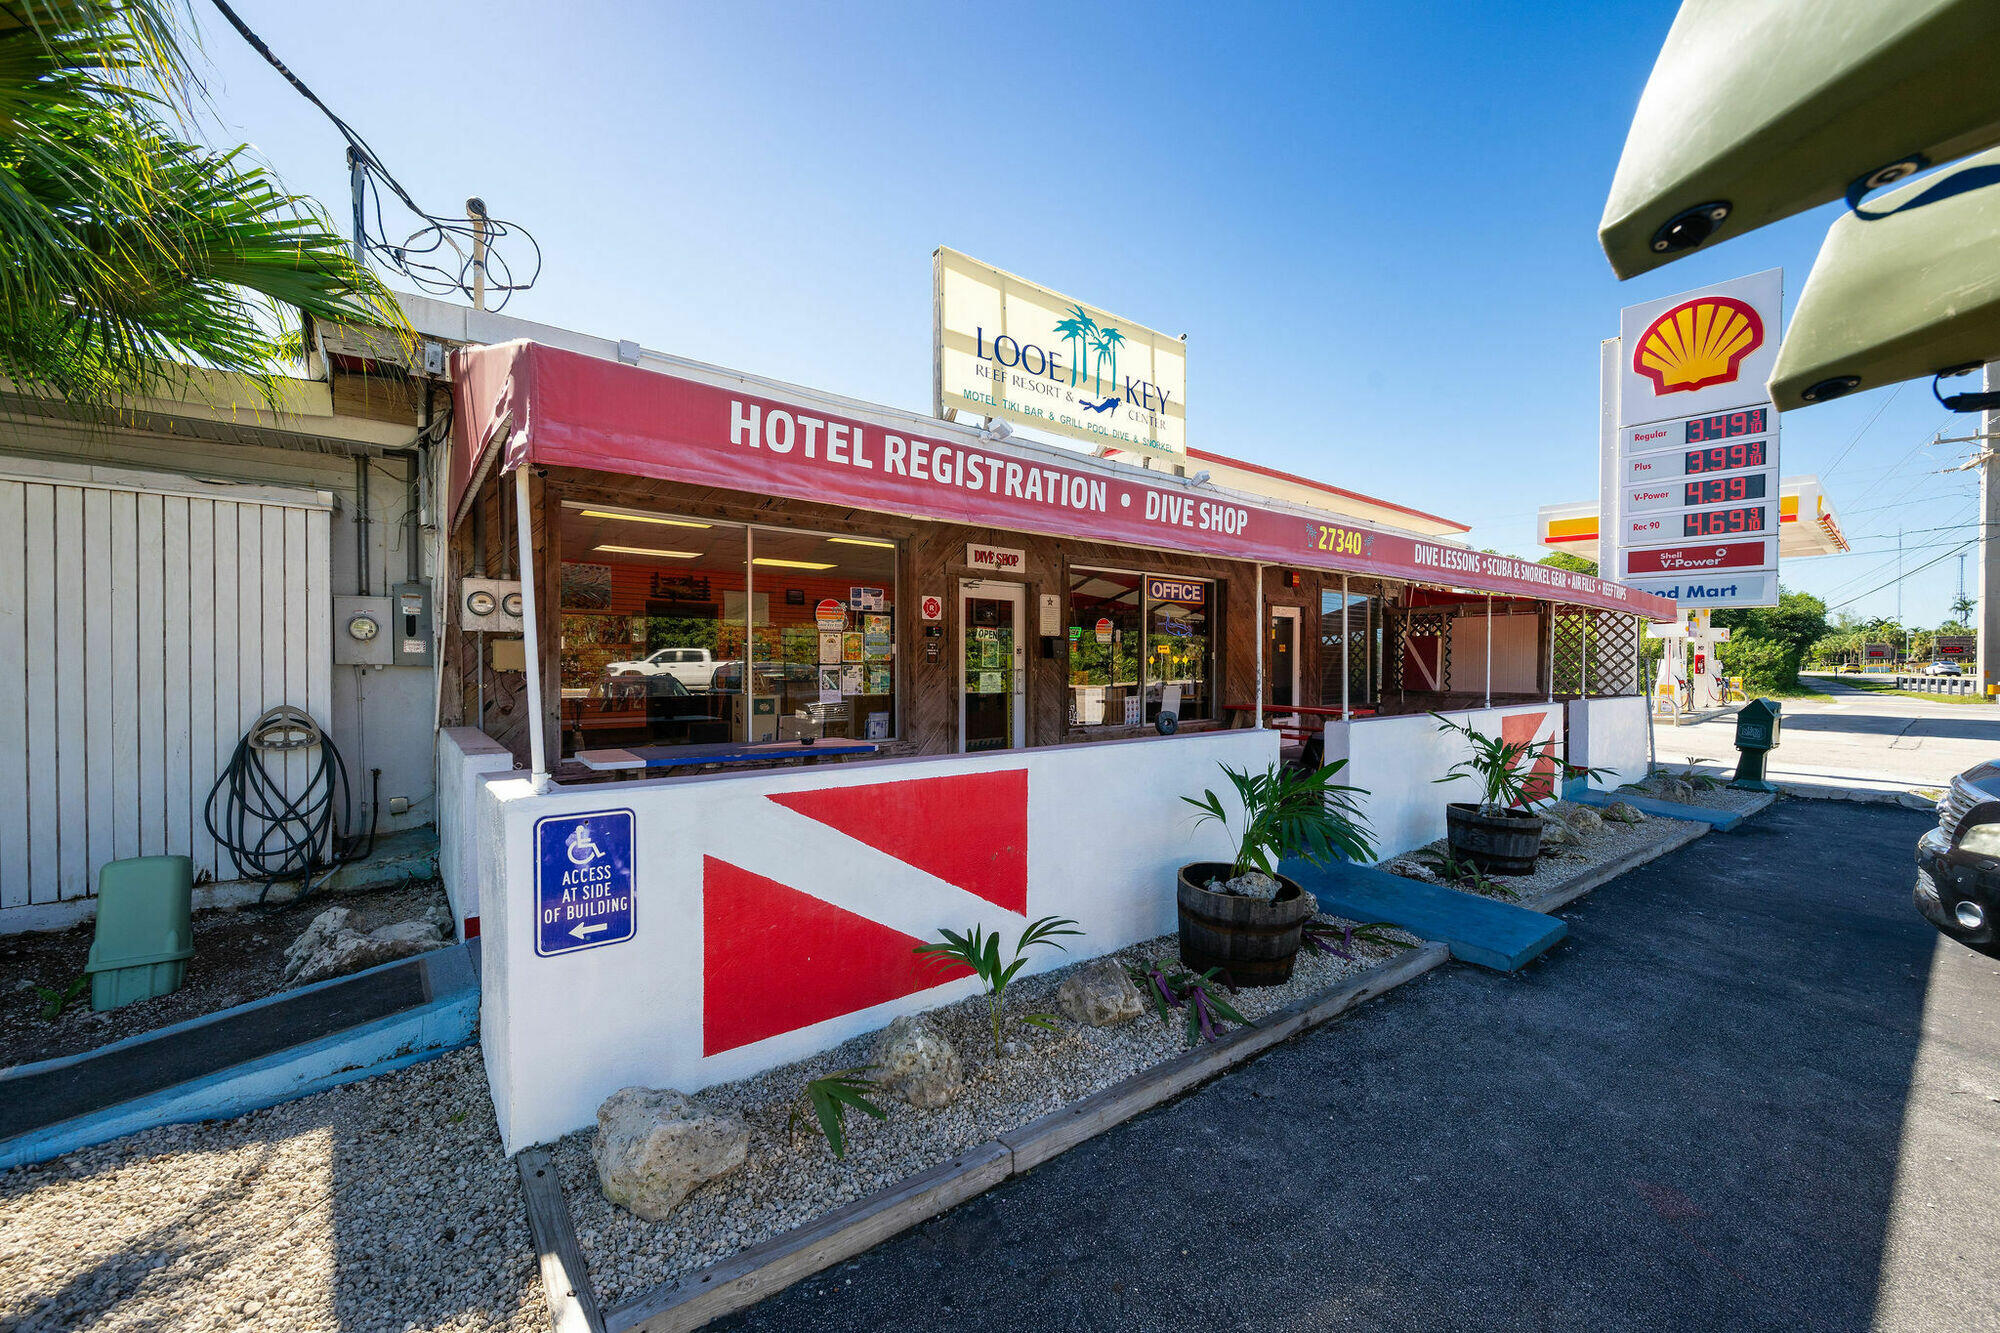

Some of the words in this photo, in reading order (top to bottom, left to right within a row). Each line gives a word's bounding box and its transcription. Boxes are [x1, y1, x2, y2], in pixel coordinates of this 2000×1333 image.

[976, 326, 1065, 384] LOOE
[1125, 375, 1171, 416] KEY
[975, 363, 1008, 384] REEF
[1012, 375, 1061, 398] RESORT
[1065, 391, 1074, 403] &
[1128, 409, 1167, 431] CENTER
[963, 388, 997, 407] MOTEL
[1002, 398, 1020, 412] TIKI
[1024, 405, 1044, 419] BAR
[1048, 411, 1055, 421] &
[1060, 414, 1083, 430] GRILL
[1087, 422, 1109, 436] POOL
[1112, 429, 1129, 441] DIVE
[1133, 435, 1139, 443] &
[1142, 437, 1174, 454] SNORKEL
[1688, 412, 1748, 443] 3.49
[1634, 429, 1668, 442] Regular
[730, 400, 873, 469] HOTEL
[884, 435, 1106, 513] REGISTRATION
[1145, 491, 1194, 527] DIVE
[1199, 502, 1249, 535] SHOP
[1634, 461, 1652, 472] Plus
[1688, 444, 1747, 474] 3.99
[1634, 491, 1669, 501] V-Power
[1687, 477, 1746, 505] 4.39
[1633, 522, 1648, 531] Rec
[1649, 521, 1660, 530] 90
[1687, 509, 1745, 536] 4.69
[1318, 525, 1362, 555] 27340
[974, 550, 994, 564] DIVE
[996, 553, 1019, 567] SHOP
[1414, 544, 1438, 566] DIVE
[1440, 549, 1481, 573] LESSONS
[1487, 557, 1513, 578] SCUBA
[1513, 564, 1520, 578] &
[1521, 565, 1550, 585] SNORKEL
[1551, 571, 1566, 588] GEAR
[1660, 551, 1683, 560] Shell
[1660, 557, 1721, 569] V-Power
[1151, 581, 1201, 600] OFFICE
[1687, 585, 1737, 598] Mart
[978, 629, 998, 640] OPEN
[562, 865, 612, 886] ACCESS
[562, 887, 578, 904] AT
[583, 882, 612, 901] SIDE
[544, 907, 562, 924] OF
[567, 897, 628, 921] BUILDING
